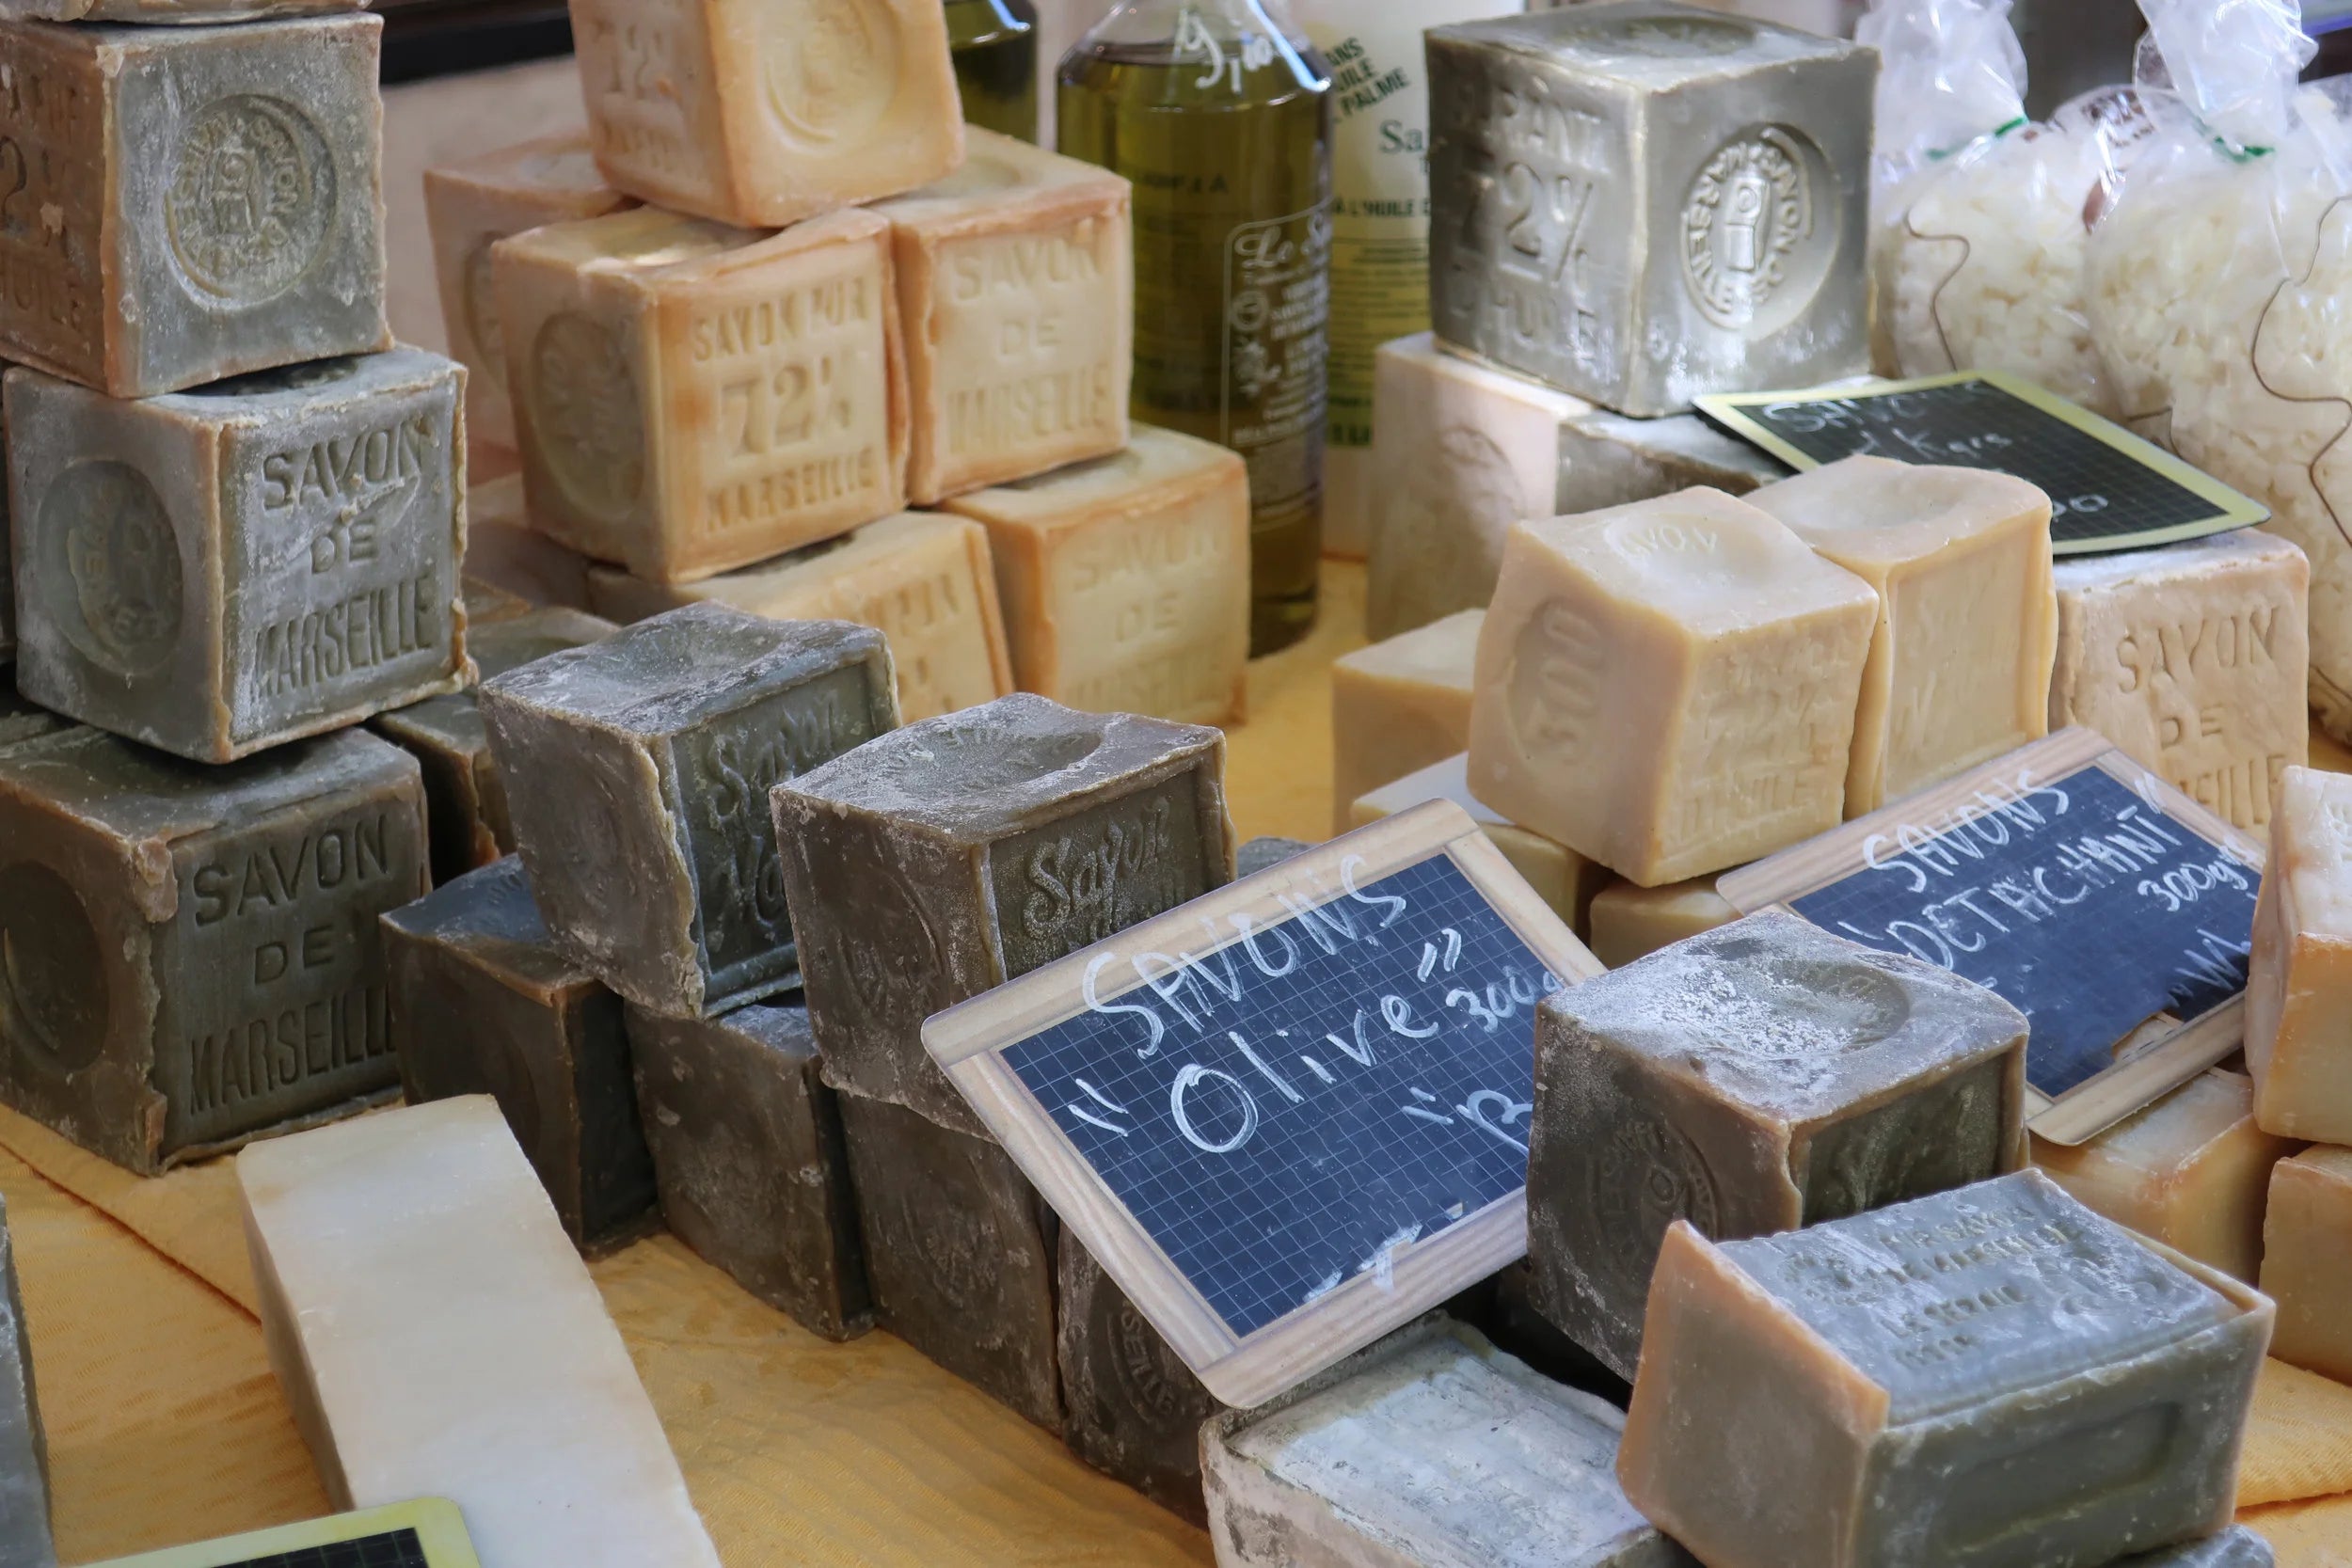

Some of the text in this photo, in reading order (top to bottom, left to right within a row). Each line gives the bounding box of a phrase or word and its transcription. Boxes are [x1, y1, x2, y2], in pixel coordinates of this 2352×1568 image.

[1325, 37, 1364, 66] ANS
[1340, 66, 1410, 117] PALME
[952, 240, 1104, 302] SAVON
[691, 292, 800, 362] SAVON
[1001, 309, 1064, 357] DE
[262, 420, 425, 513] SAVON
[707, 447, 877, 532] MARSEILLE
[310, 518, 380, 575] DE
[252, 572, 438, 699] MARSEILLE
[2116, 605, 2282, 694] SAVON
[2161, 705, 2223, 751] DE
[1023, 797, 1170, 940] Savon
[1862, 769, 2071, 894] SAVONS
[193, 814, 389, 927] SAVON
[254, 925, 337, 986] DE
[1082, 854, 1407, 1060] SAVONS
